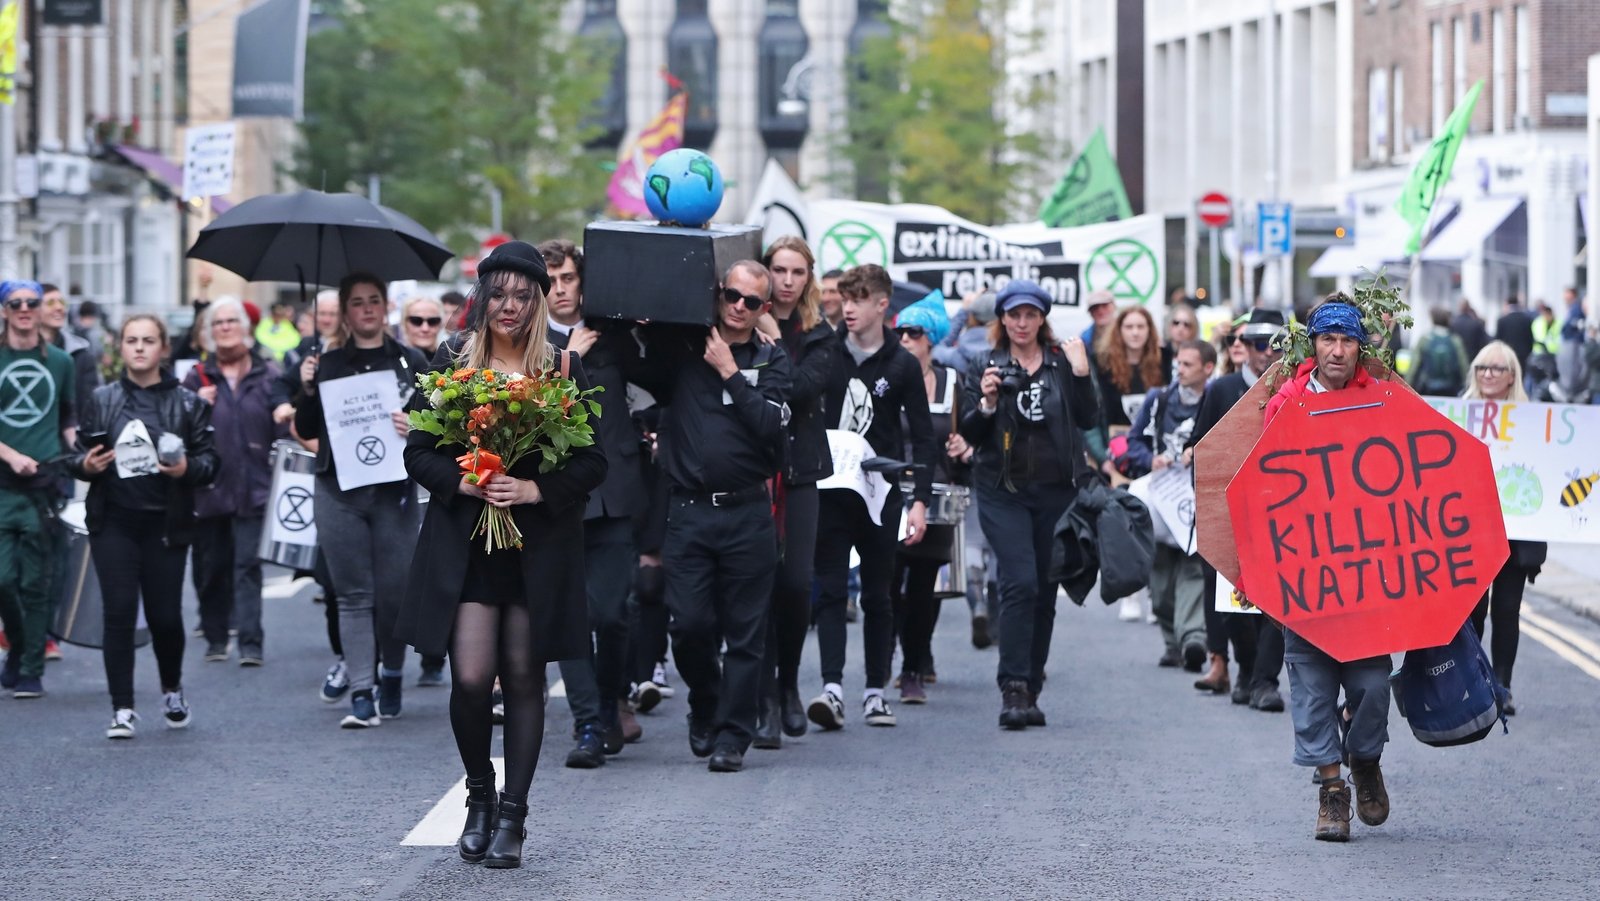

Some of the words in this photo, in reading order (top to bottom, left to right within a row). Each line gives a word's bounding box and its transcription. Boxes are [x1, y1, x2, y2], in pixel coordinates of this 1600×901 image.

[898, 226, 1044, 261] extinction
[342, 406, 366, 416] YOUR
[367, 403, 383, 412] LIFE
[344, 396, 359, 406] ACT
[361, 393, 379, 402] LIKE
[339, 415, 377, 427] DEPENDS
[1545, 407, 1577, 445] IS
[1258, 429, 1457, 512] STOP
[1268, 492, 1470, 564] KILLING
[1276, 544, 1477, 616] NATURE
